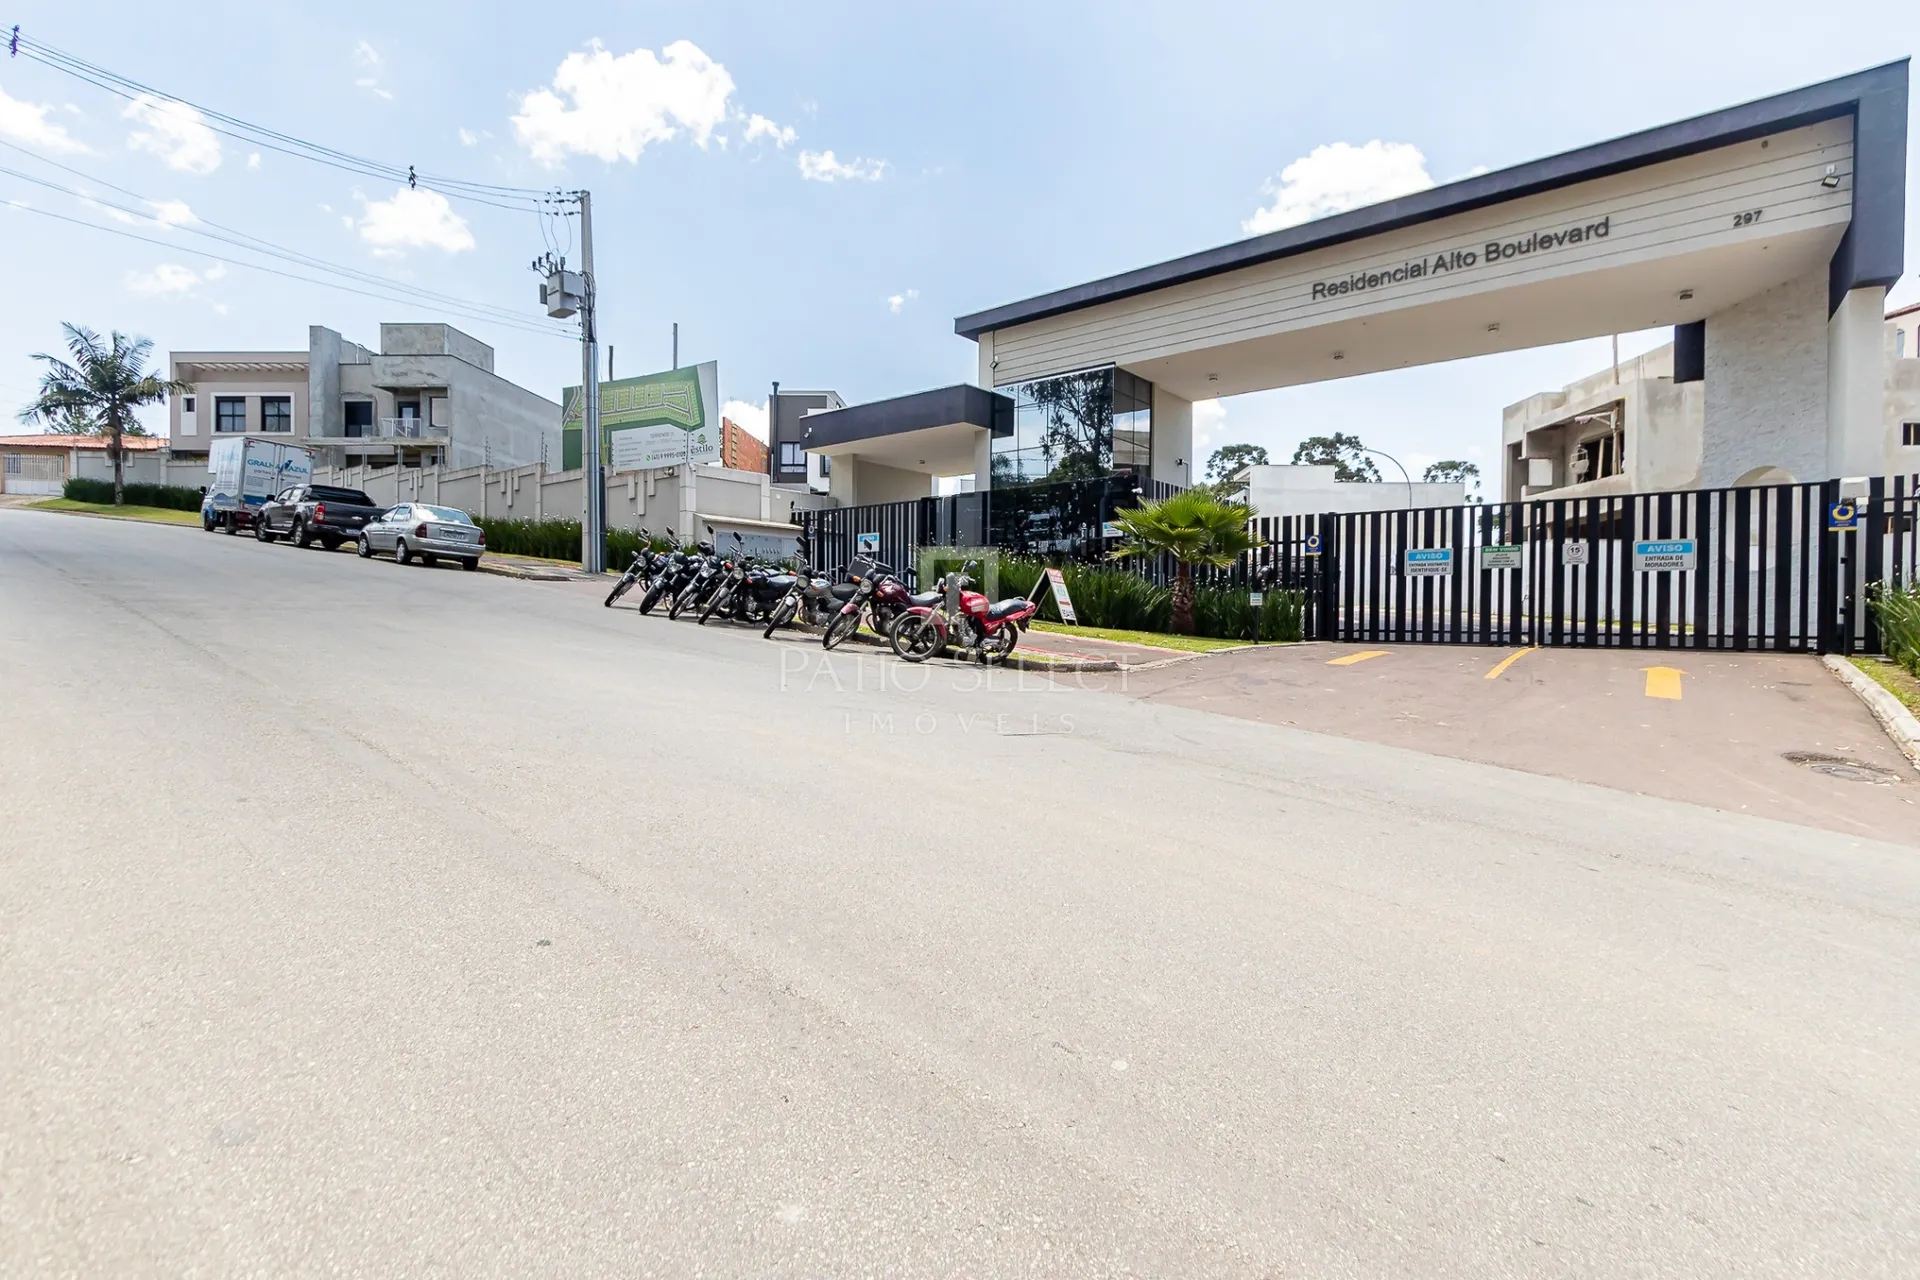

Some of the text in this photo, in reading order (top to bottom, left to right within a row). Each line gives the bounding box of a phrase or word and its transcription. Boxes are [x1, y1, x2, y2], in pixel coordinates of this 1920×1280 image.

[1733, 209, 1763, 227] 297
[1312, 216, 1610, 301] Residencial Alto Boulevard
[247, 458, 309, 475] GRALHA AZUL
[1415, 552, 1443, 560] AVISO
[1647, 543, 1683, 553] AVISO
